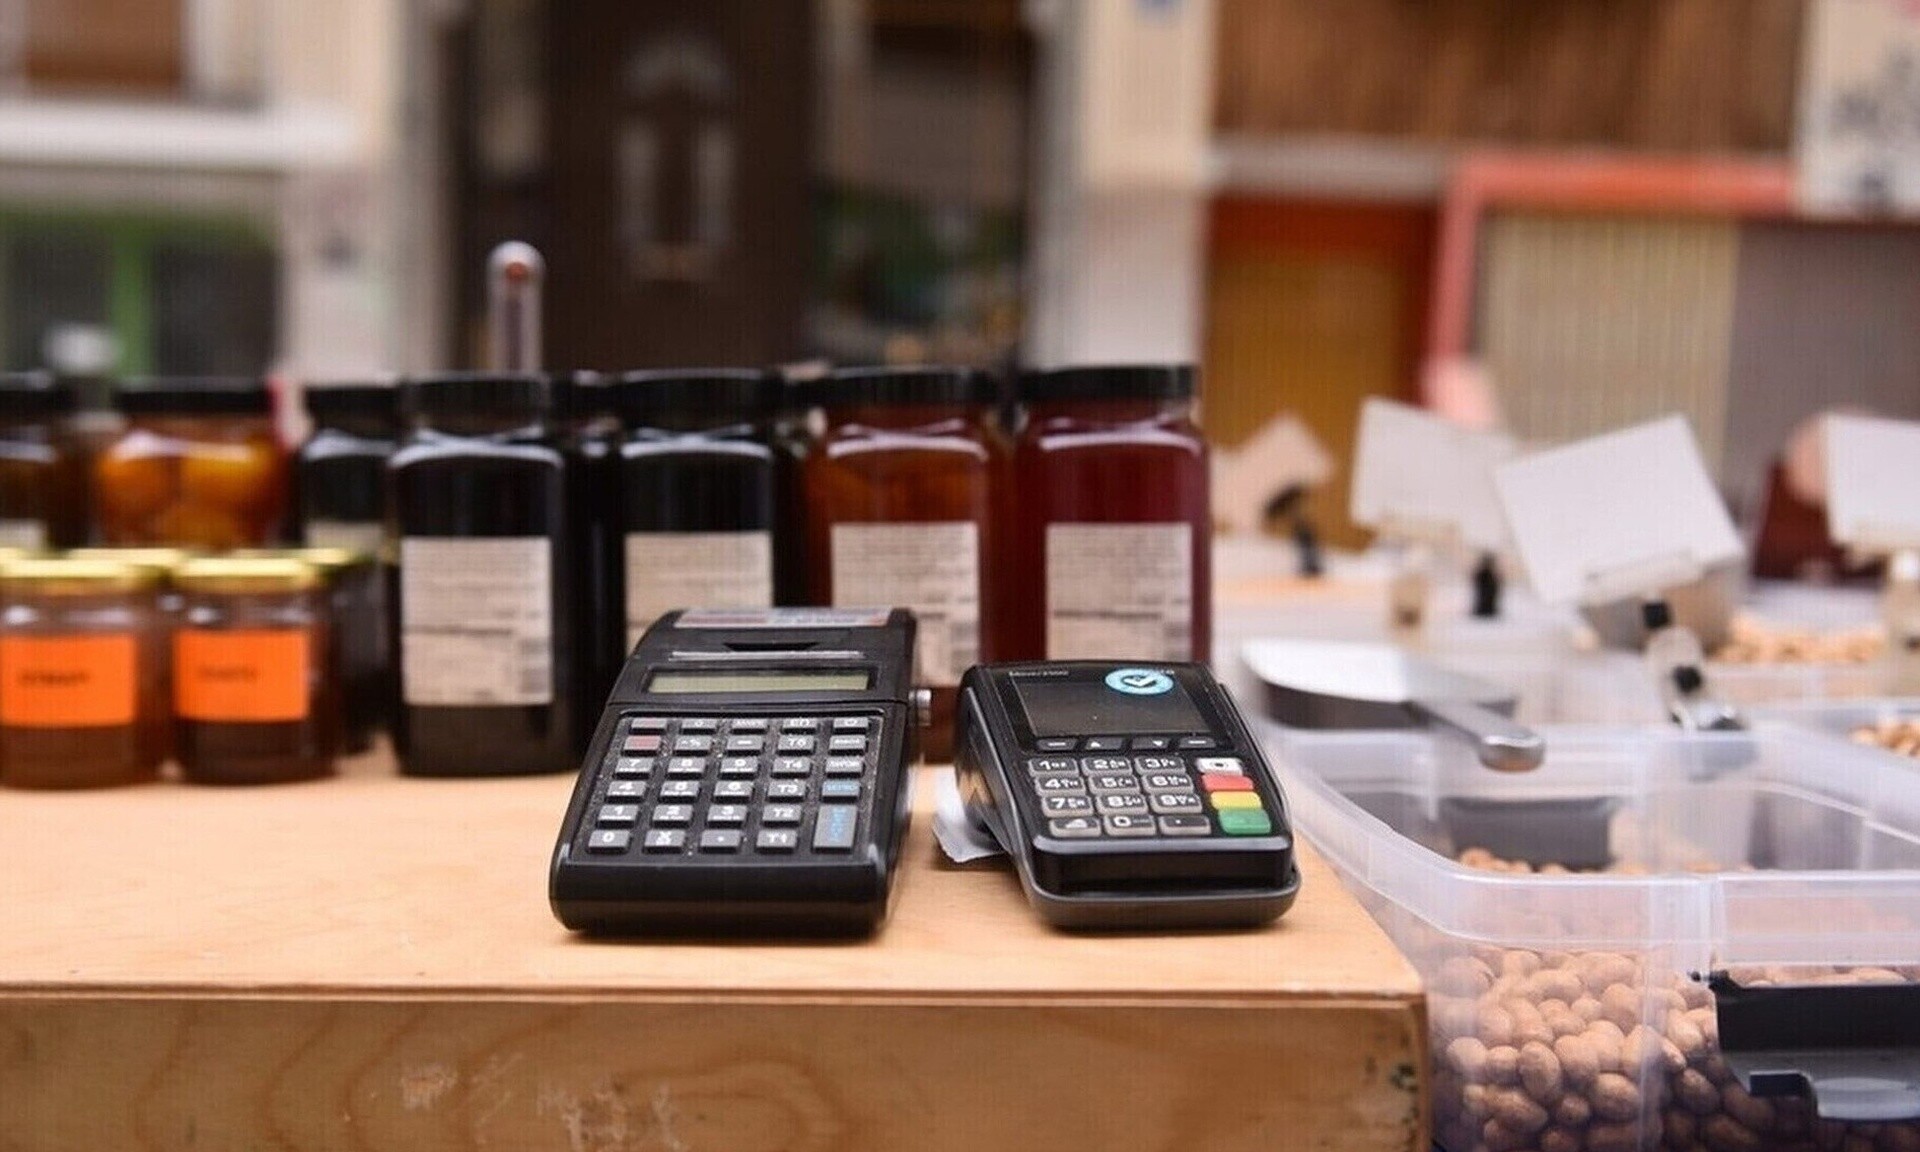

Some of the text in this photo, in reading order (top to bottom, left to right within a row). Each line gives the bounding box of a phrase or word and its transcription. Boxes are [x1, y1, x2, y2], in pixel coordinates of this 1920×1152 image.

[629, 759, 641, 767] 7
[784, 760, 802, 768] T4
[773, 808, 794, 818] T2
[1113, 816, 1131, 827] 0
[602, 831, 615, 843] 0
[767, 833, 787, 843] T1
